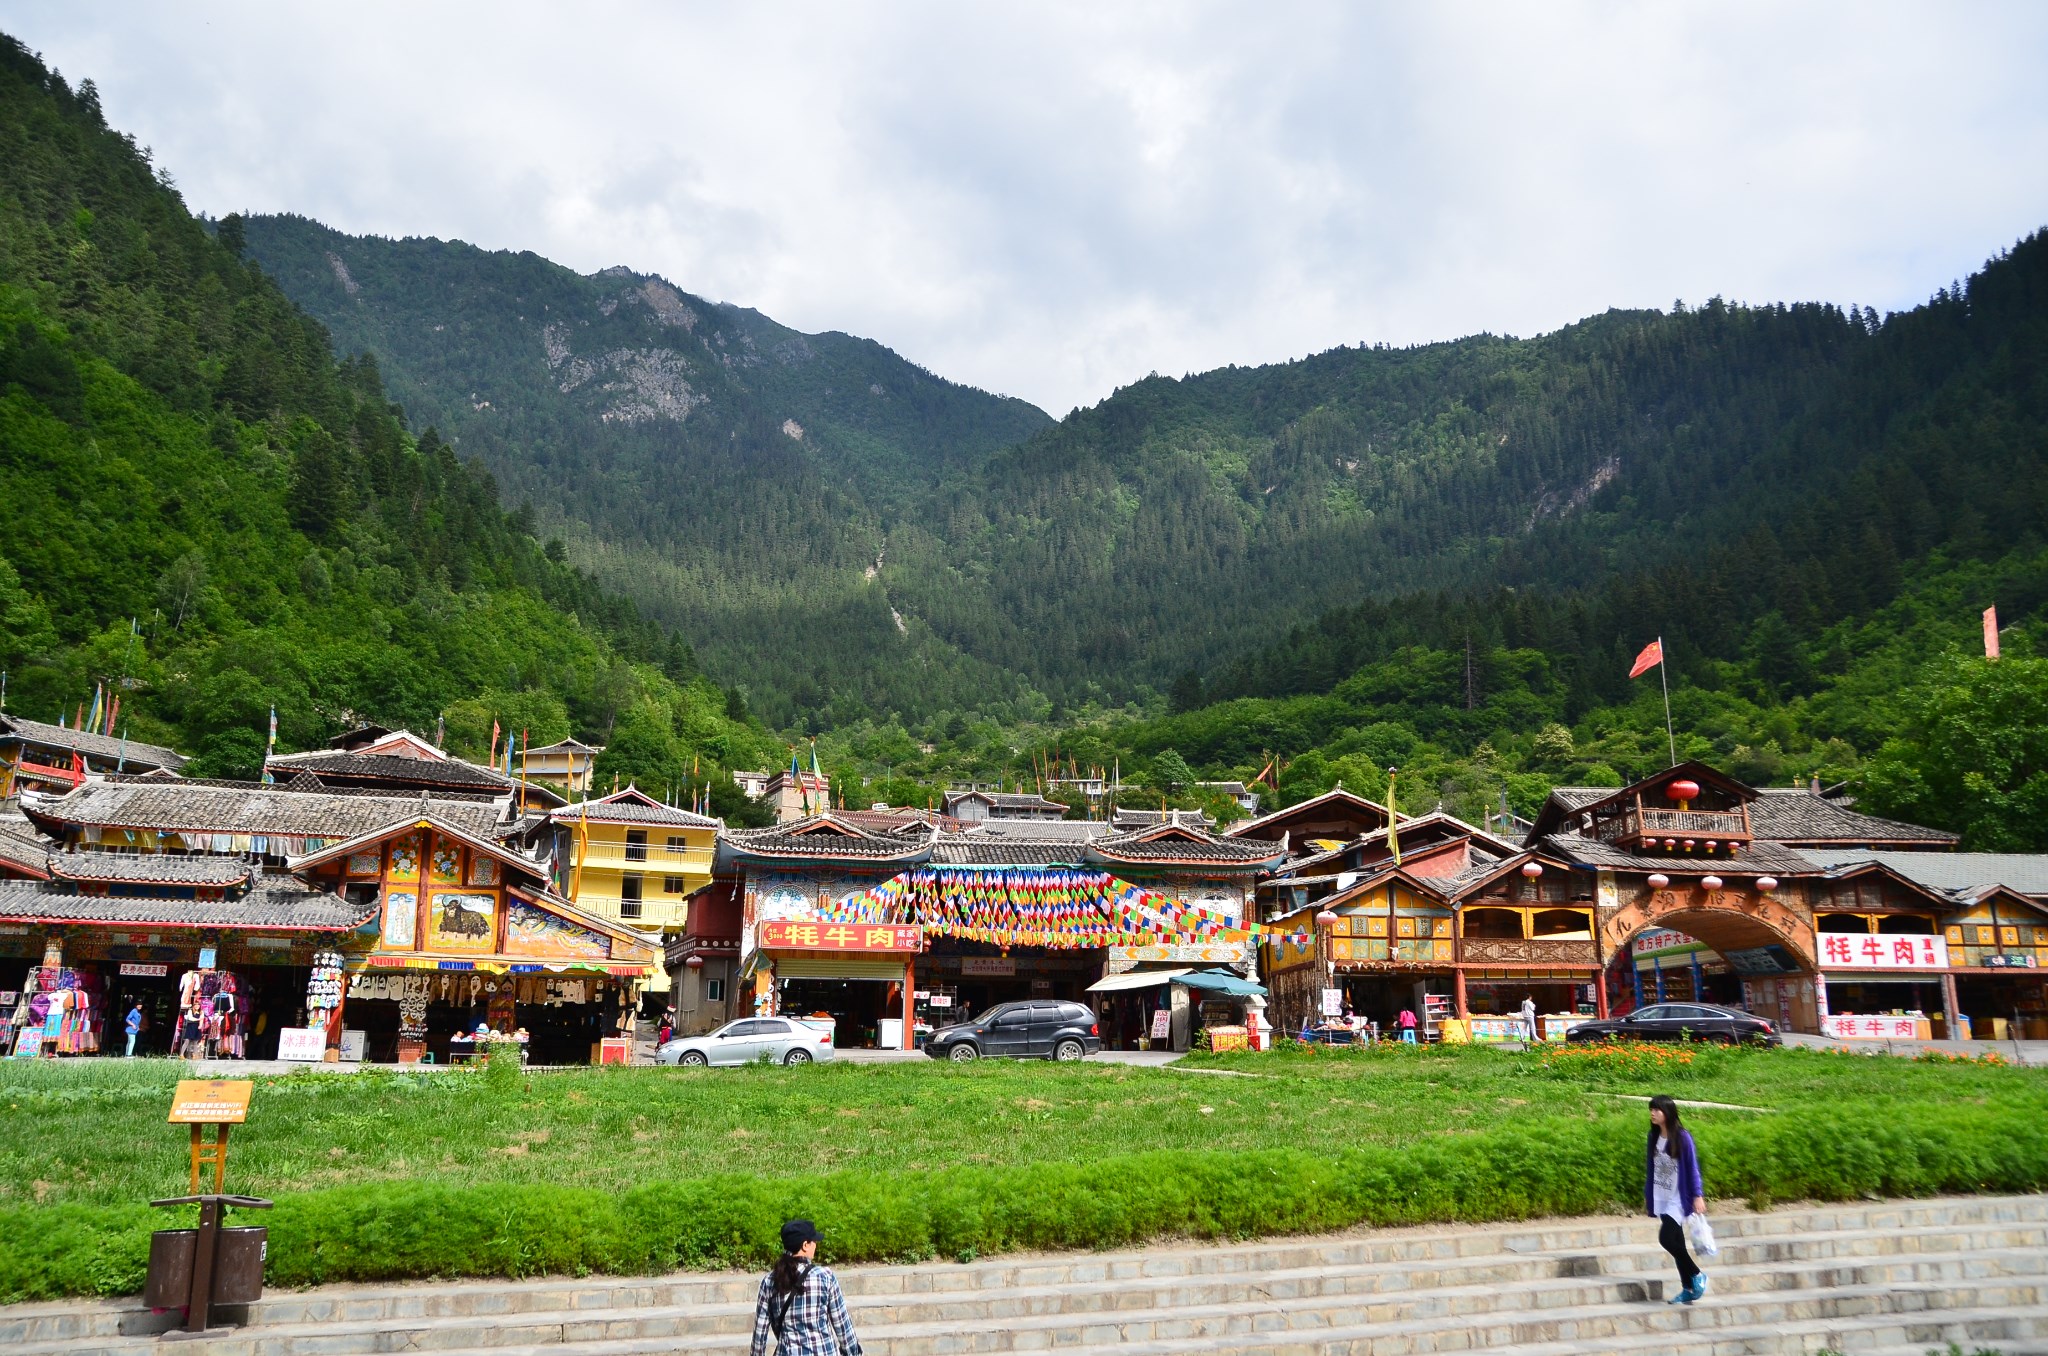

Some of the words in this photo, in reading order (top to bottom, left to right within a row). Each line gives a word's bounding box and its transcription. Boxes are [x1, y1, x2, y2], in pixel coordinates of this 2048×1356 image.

[784, 925, 895, 948] 牦牛肉
[897, 929, 914, 938] 藏家
[1637, 932, 1698, 951] 地方特产大全
[897, 939, 914, 947] 小吃
[1825, 935, 1915, 965] 牦牛肉
[1814, 974, 1828, 1028] 牦牛肉
[1836, 1019, 1913, 1036] 牦牛肉
[283, 1034, 320, 1048] 冰淇淋
